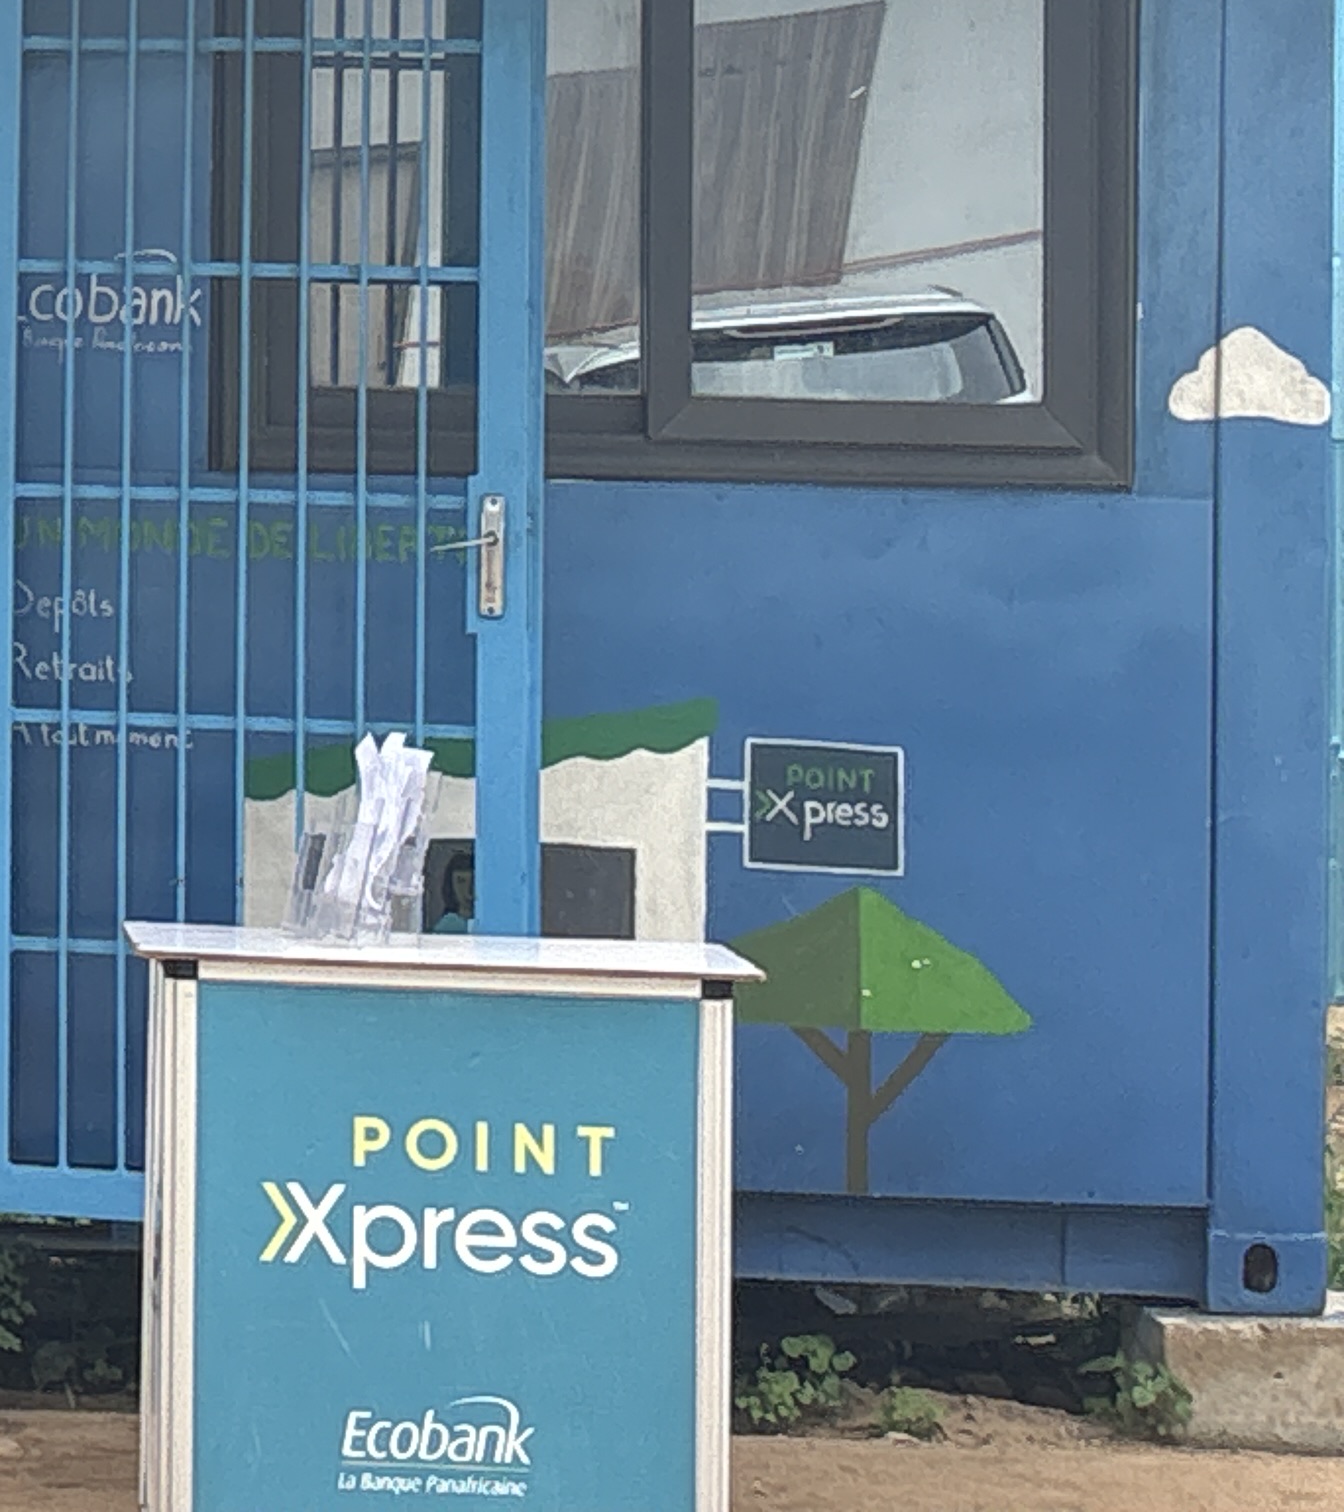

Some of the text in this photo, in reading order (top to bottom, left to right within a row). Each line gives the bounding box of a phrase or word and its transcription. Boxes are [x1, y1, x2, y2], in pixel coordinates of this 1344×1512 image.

[17, 273, 202, 327] cobank
[248, 519, 294, 562] DE
[785, 762, 876, 794] POINT
[765, 788, 890, 842] Xpress
[352, 1116, 616, 1177] POINT
[282, 1182, 621, 1290] Xpress
[340, 1394, 536, 1466] Ecobank
[337, 1471, 528, 1498] La Banque Panafricaine
